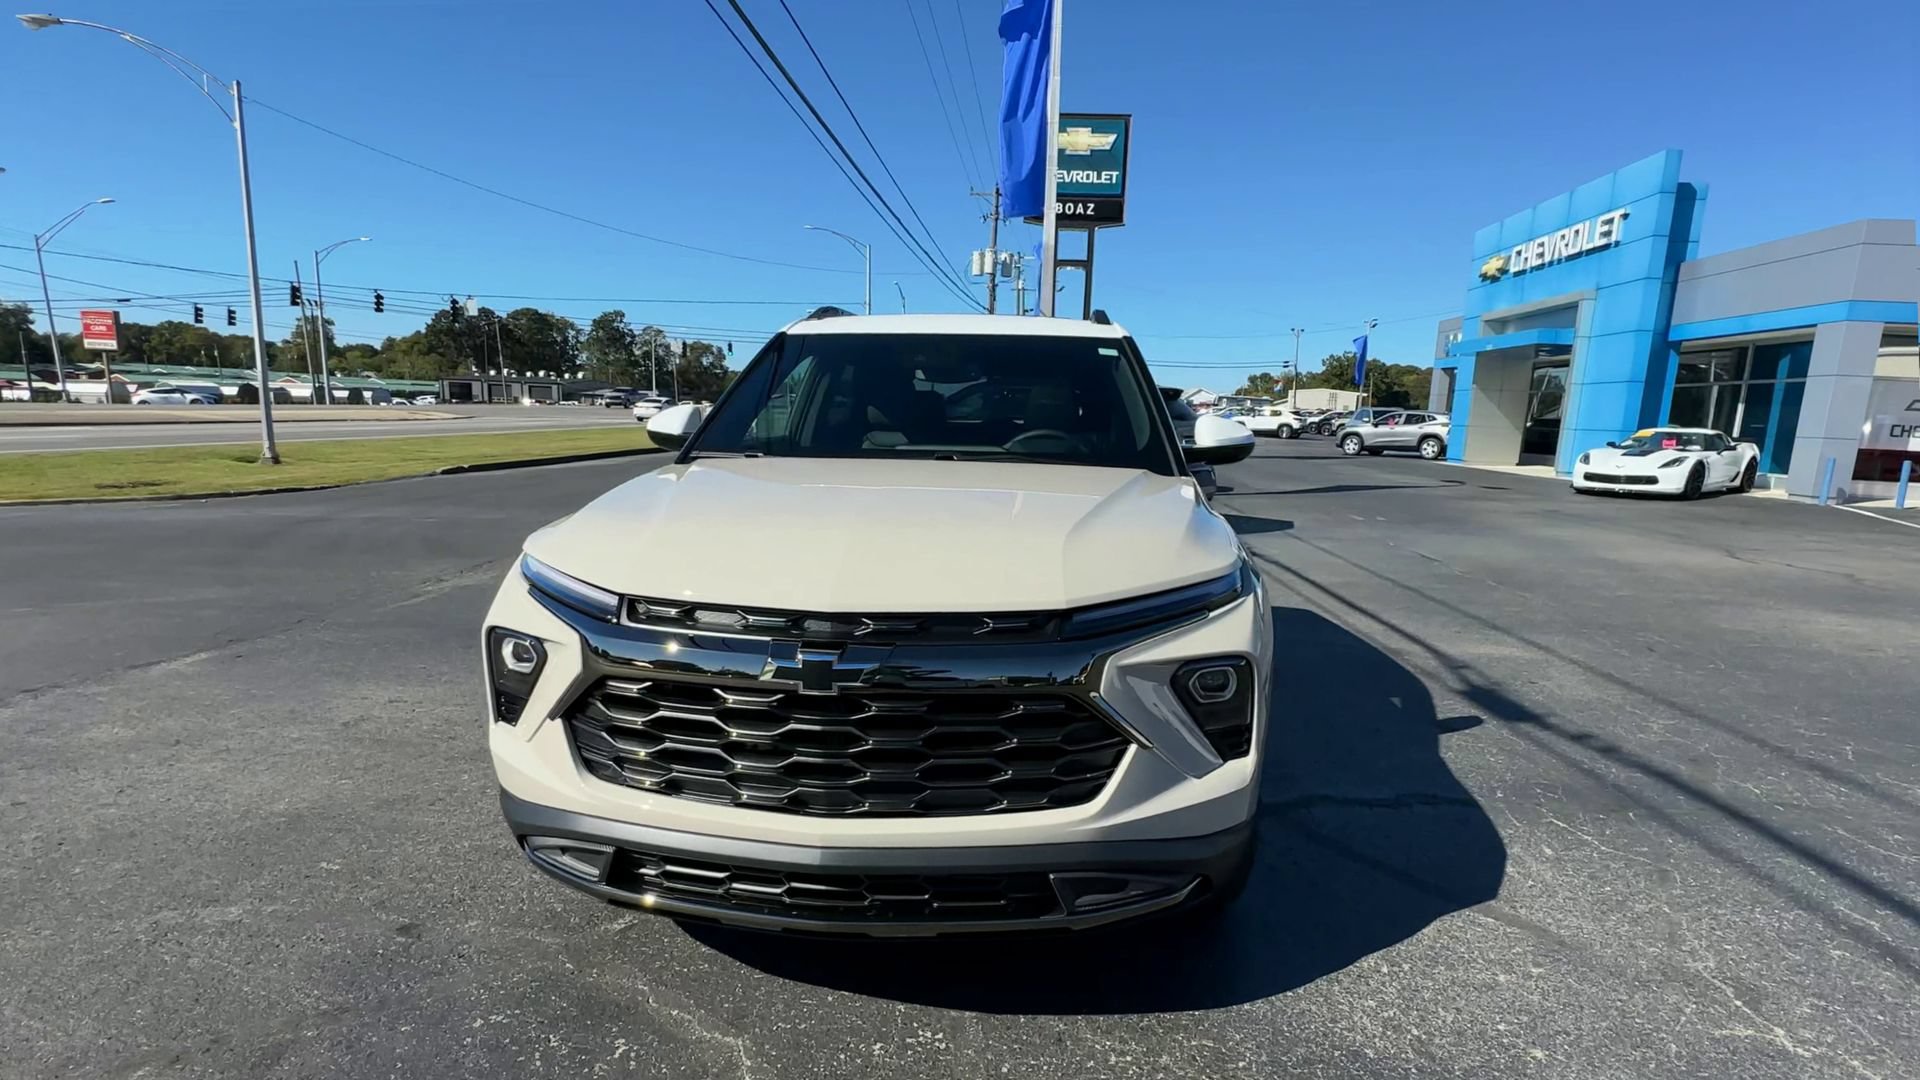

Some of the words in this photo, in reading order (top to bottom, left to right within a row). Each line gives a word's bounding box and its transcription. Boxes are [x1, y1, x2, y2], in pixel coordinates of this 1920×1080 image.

[1056, 169, 1119, 184] EVROLET
[1055, 202, 1095, 215] BOAZ
[1510, 208, 1629, 273] CHEVROLET
